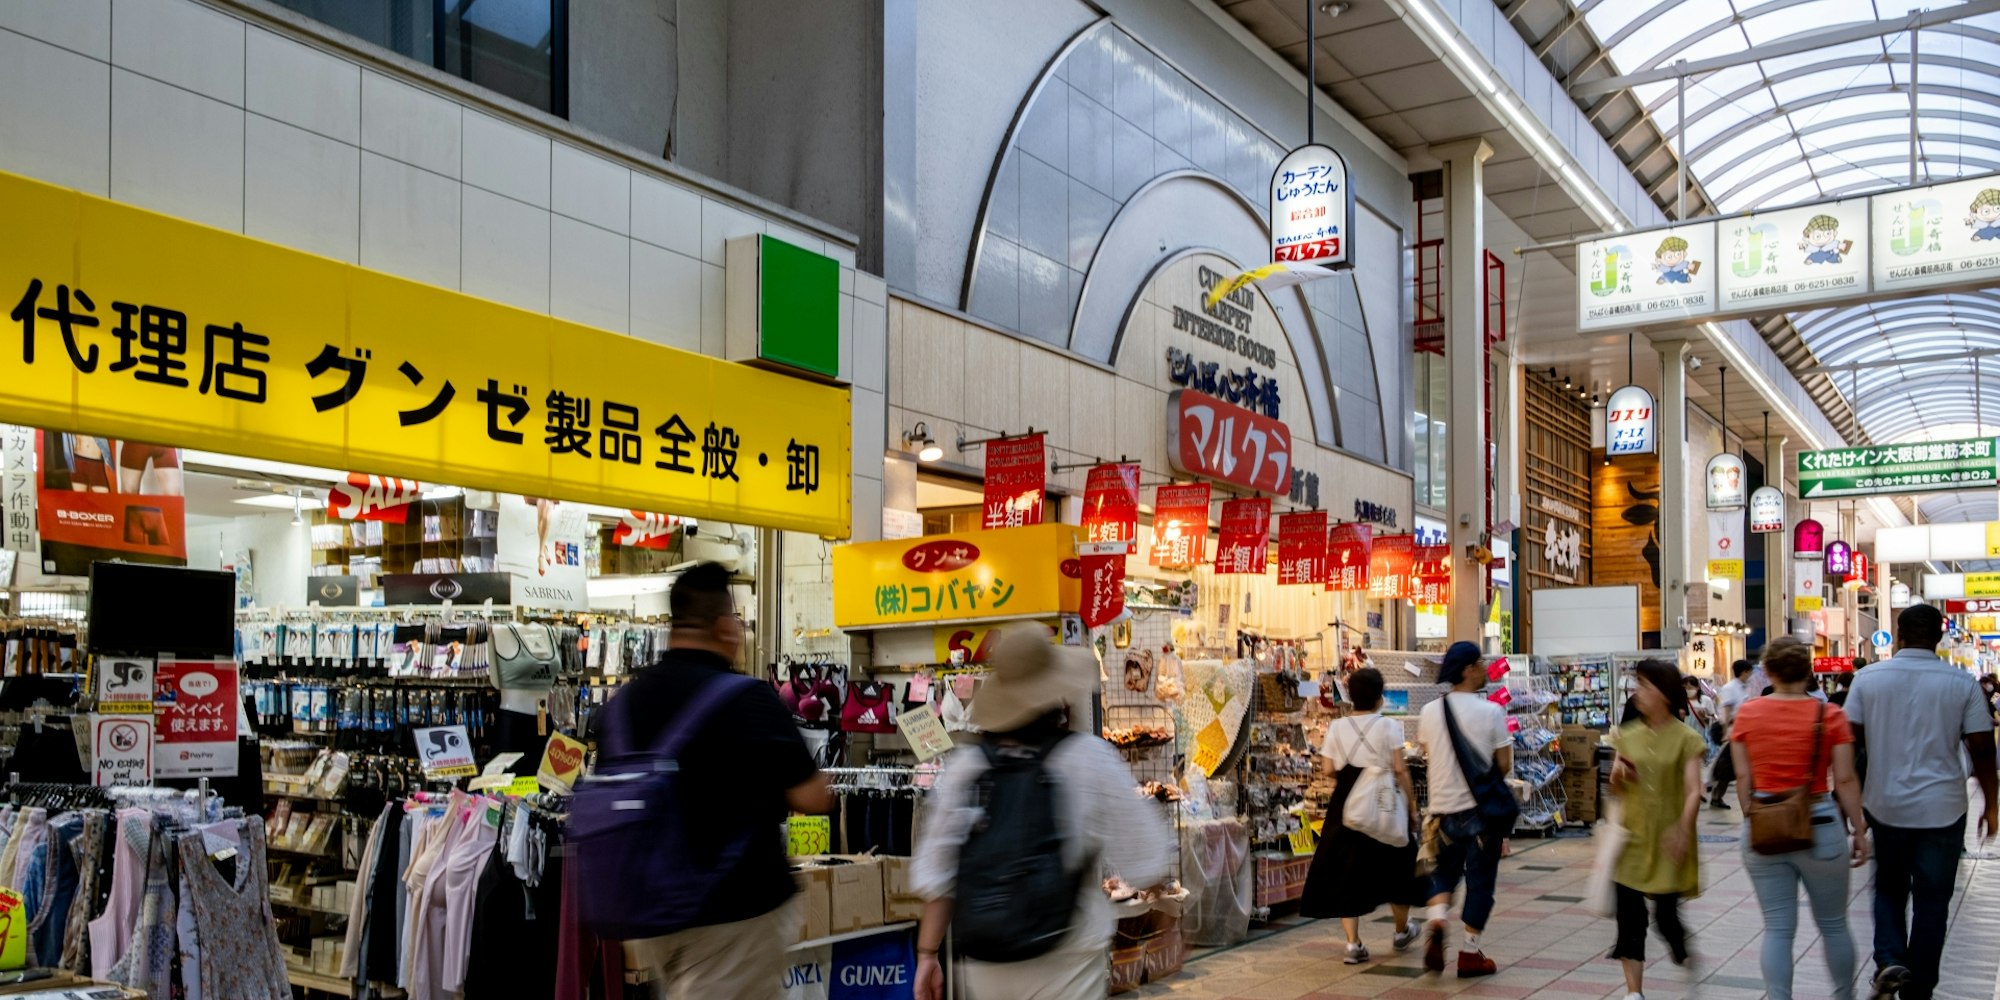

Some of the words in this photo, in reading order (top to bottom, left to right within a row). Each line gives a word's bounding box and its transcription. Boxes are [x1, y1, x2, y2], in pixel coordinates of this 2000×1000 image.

[1282, 165, 1333, 185] カーテン
[1276, 180, 1339, 202] じゅうたん
[1276, 240, 1338, 261] マルクラ
[1794, 276, 1855, 292] 06-6251-0838
[1647, 295, 1704, 311] 06-6251-0838
[10, 278, 270, 404] 代理店
[1172, 304, 1237, 353] INTERIOR
[1237, 333, 1276, 370] GOODS
[1608, 407, 1651, 423] クスリ
[1183, 404, 1289, 493] マルクラ
[1801, 439, 1992, 470] くれたけイン大阪御堂筋本町
[1874, 465, 1901, 475] OSAKA
[1217, 545, 1267, 573] 半額!!
[1280, 557, 1326, 585] 半額!!
[1327, 564, 1370, 591] 半額!!
[524, 586, 573, 602] SABRINA
[874, 577, 1016, 616] (株)コバヤシ
[171, 702, 225, 717] ペイペイ
[902, 710, 930, 727] SUMMER
[170, 717, 229, 733] 使えます。
[100, 759, 114, 769] NO
[113, 769, 131, 779] and
[839, 963, 908, 987] GUNZE
